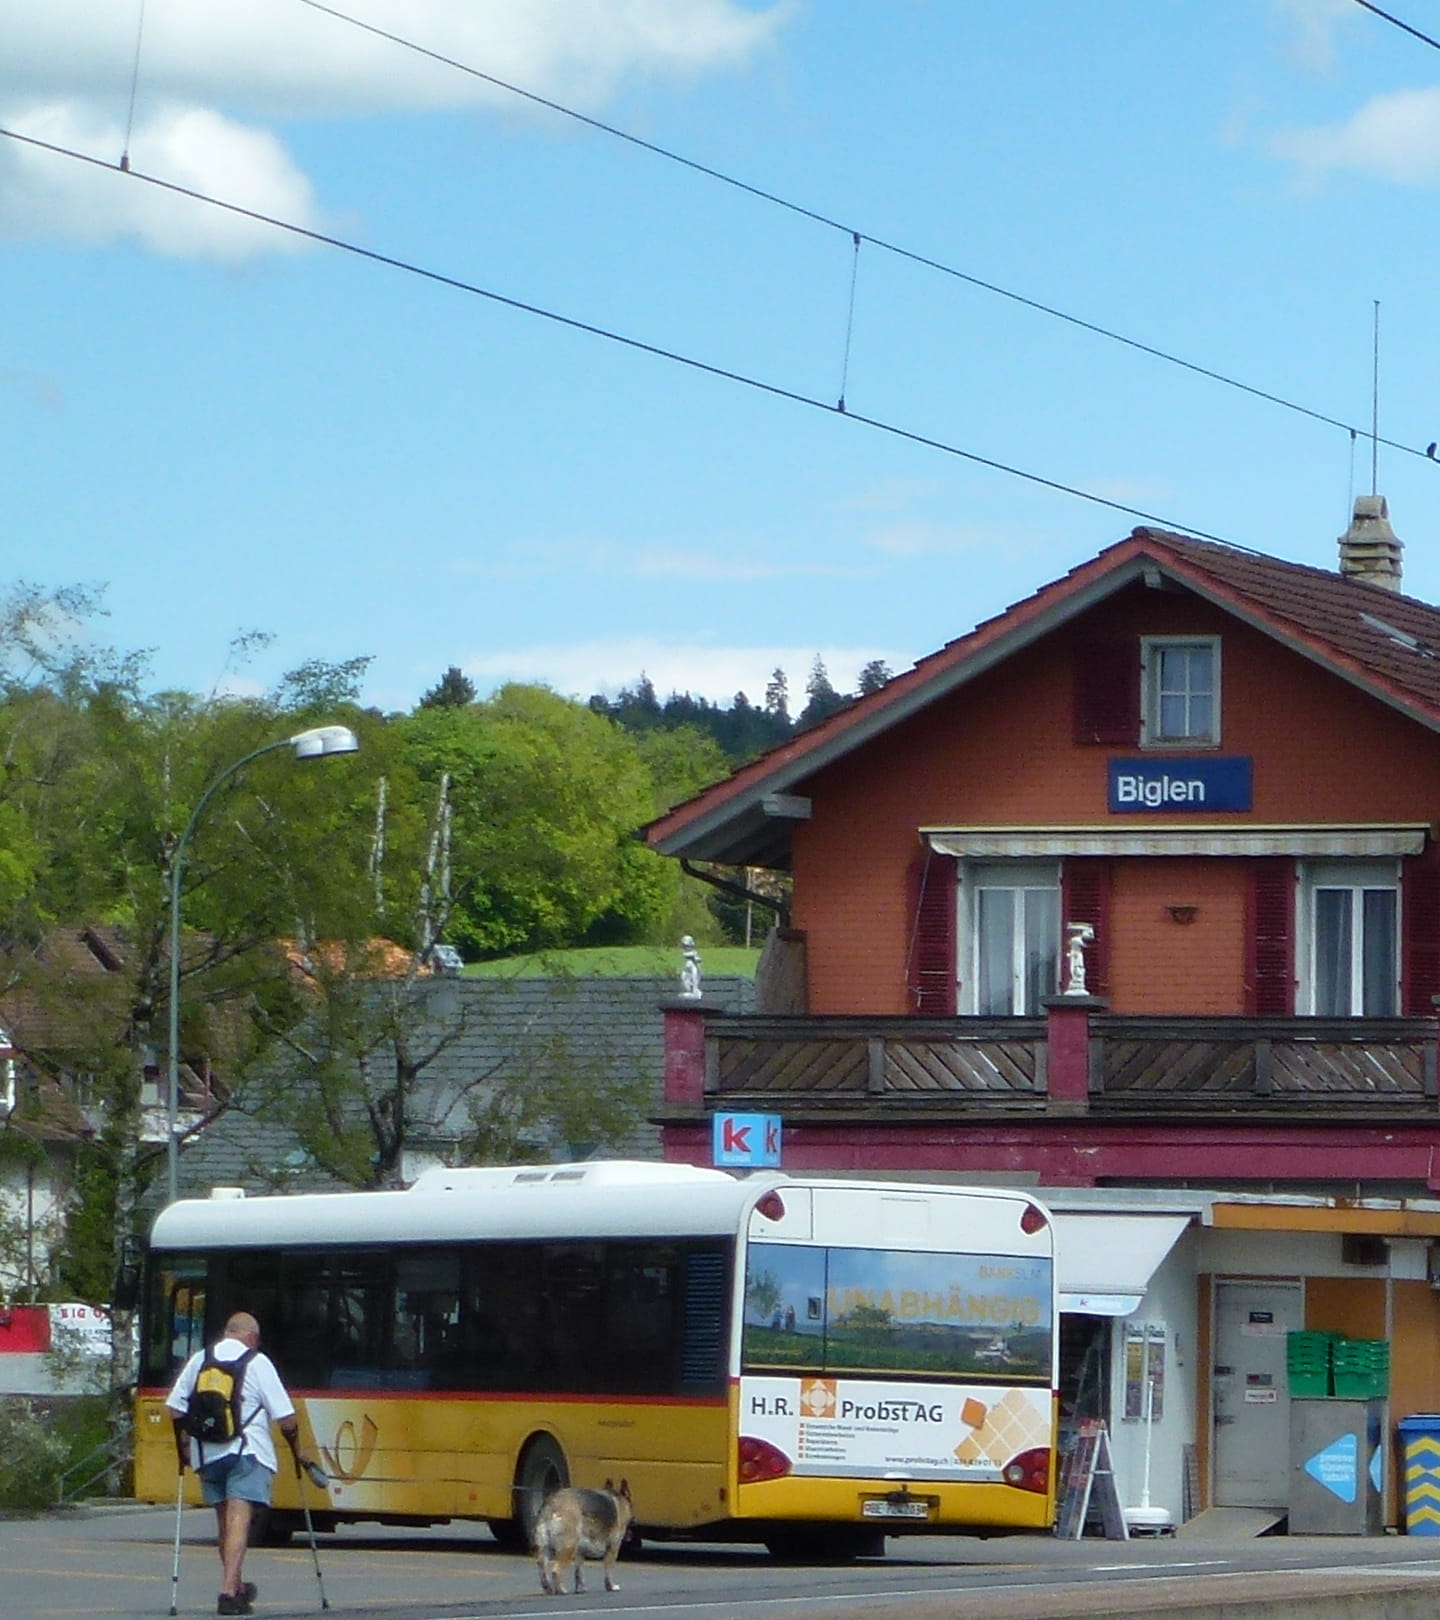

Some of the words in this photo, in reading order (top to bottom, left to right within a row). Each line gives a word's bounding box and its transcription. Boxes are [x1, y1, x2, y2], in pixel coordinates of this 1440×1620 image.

[1118, 776, 1205, 806] Biglen
[828, 1284, 1040, 1325] UNABHÄNGIG
[751, 1396, 794, 1416] H.R.
[841, 1400, 909, 1421] Probst
[914, 1404, 943, 1422] AG
